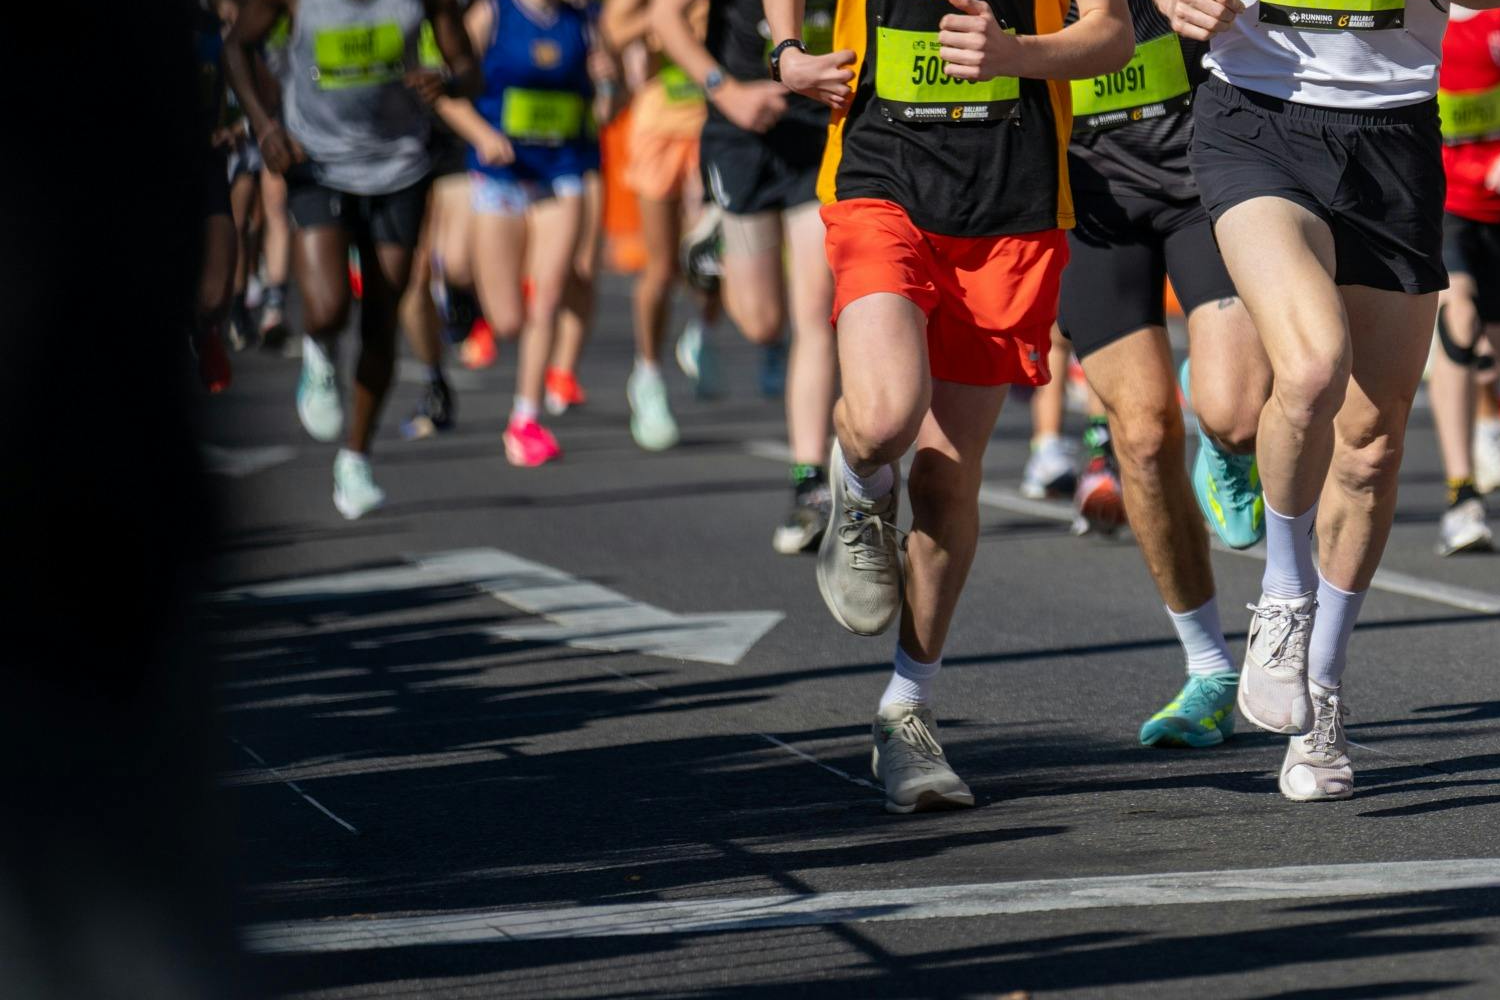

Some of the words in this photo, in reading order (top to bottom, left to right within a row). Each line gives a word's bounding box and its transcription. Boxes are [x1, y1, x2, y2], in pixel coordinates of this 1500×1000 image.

[1301, 12, 1332, 22] RUNNING
[1094, 63, 1146, 98] 51091
[915, 107, 947, 115] RUNNING
